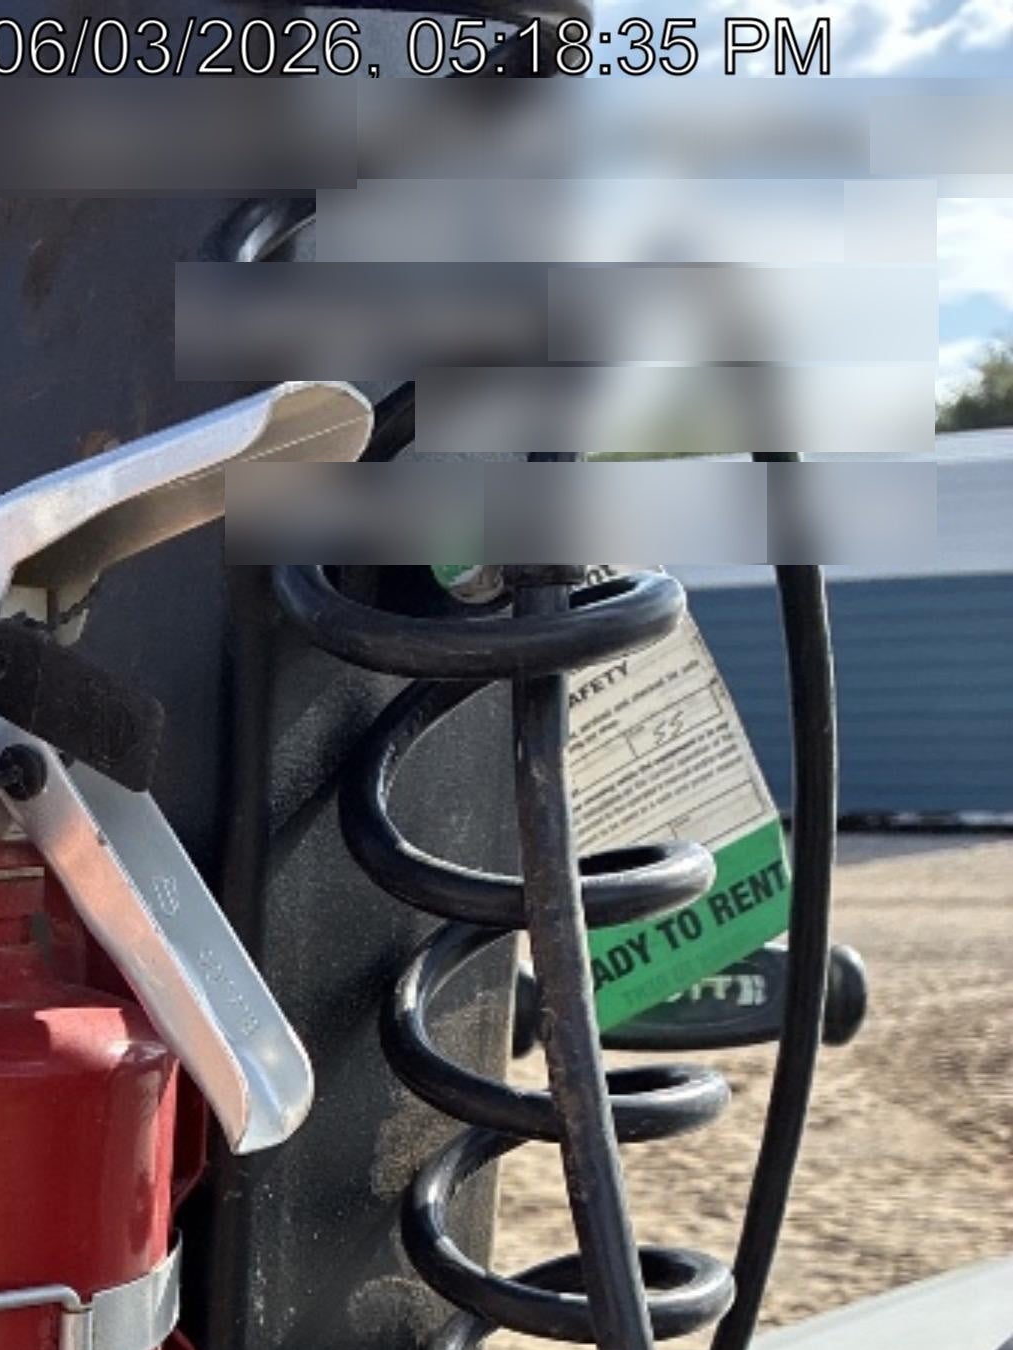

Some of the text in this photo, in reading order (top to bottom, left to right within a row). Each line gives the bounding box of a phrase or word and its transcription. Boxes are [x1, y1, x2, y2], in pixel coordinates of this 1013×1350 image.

[568, 660, 630, 708] AFETY
[593, 932, 653, 992] ADY
[656, 908, 703, 950] TO
[709, 859, 786, 926] RENT
